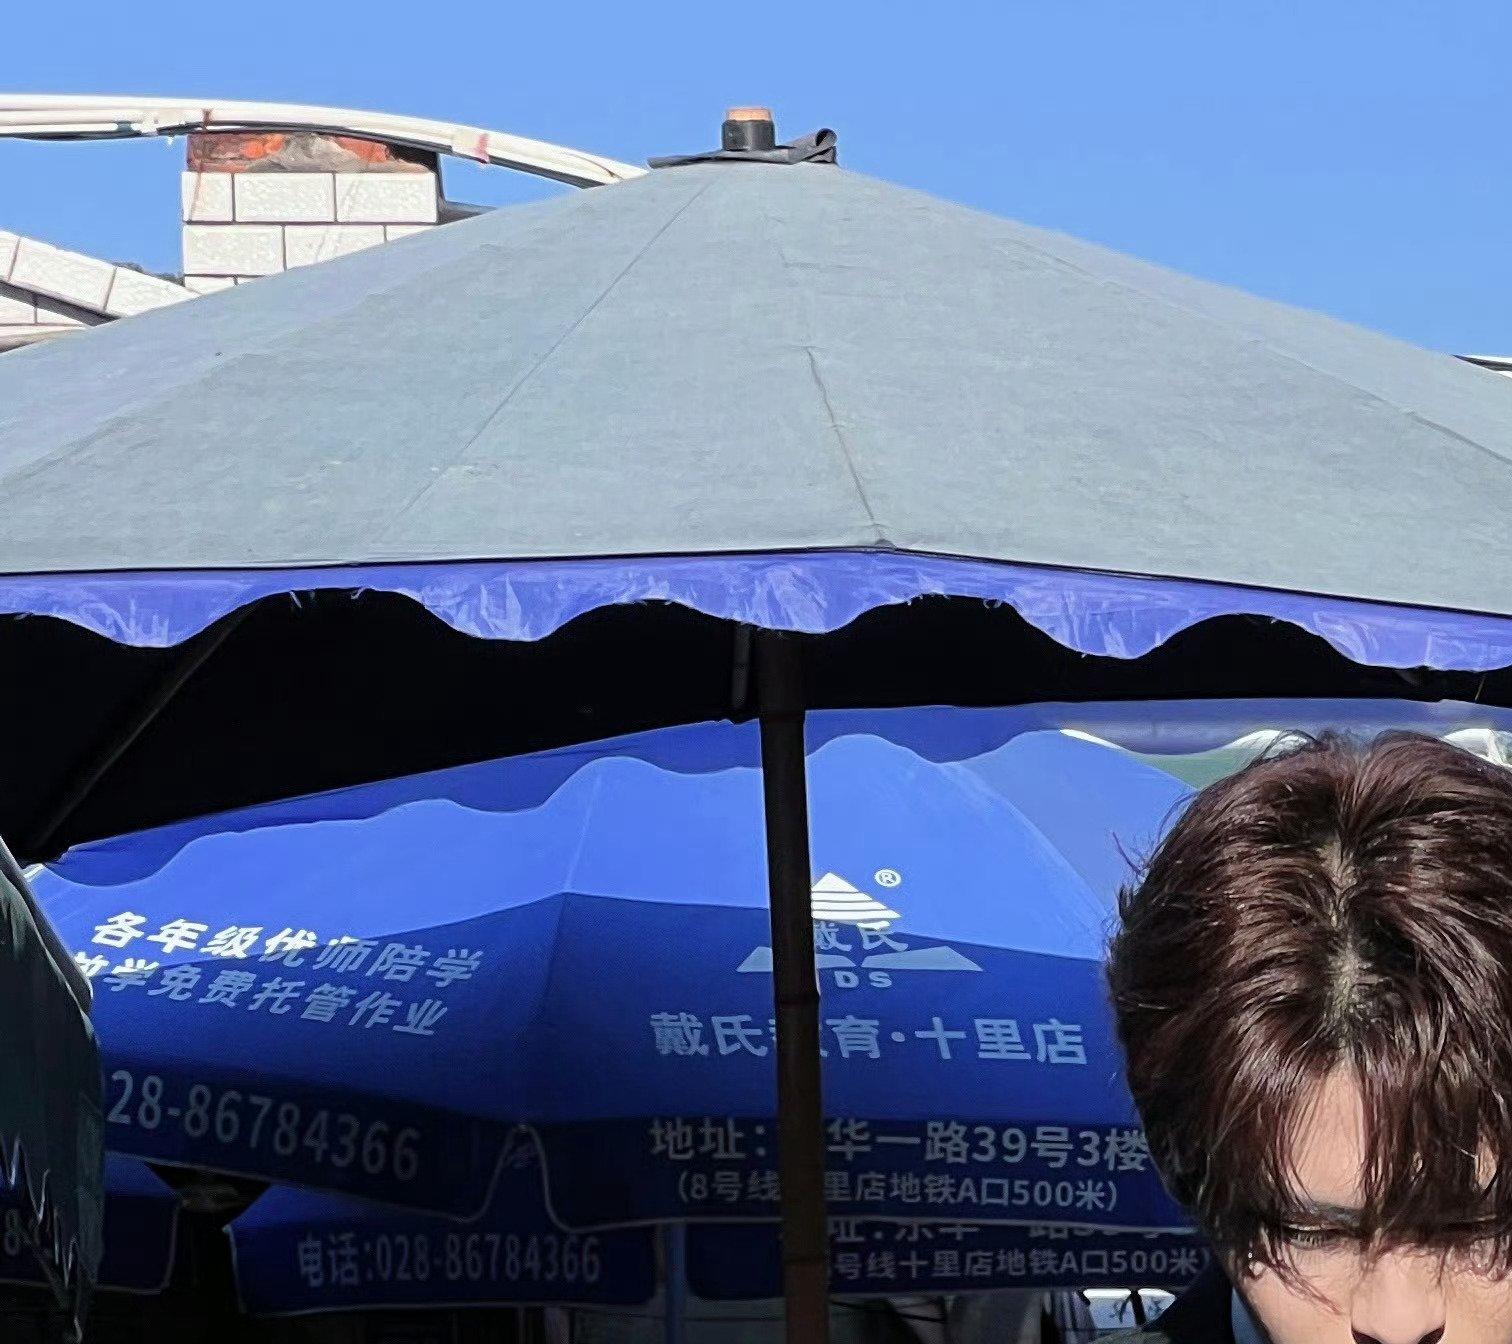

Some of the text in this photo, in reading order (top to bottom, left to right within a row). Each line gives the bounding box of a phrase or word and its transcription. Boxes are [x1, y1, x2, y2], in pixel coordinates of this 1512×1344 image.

[92, 911, 483, 990] 各年级优师陪学
[649, 1010, 1089, 1066] 戴氏育·十里店
[648, 1116, 1148, 1173] 地址：华一路39号3楼
[677, 1168, 1118, 1213] (8号线里店地铁A口500米)
[827, 1247, 1210, 1283] 号线十里店地铁A口500米)
